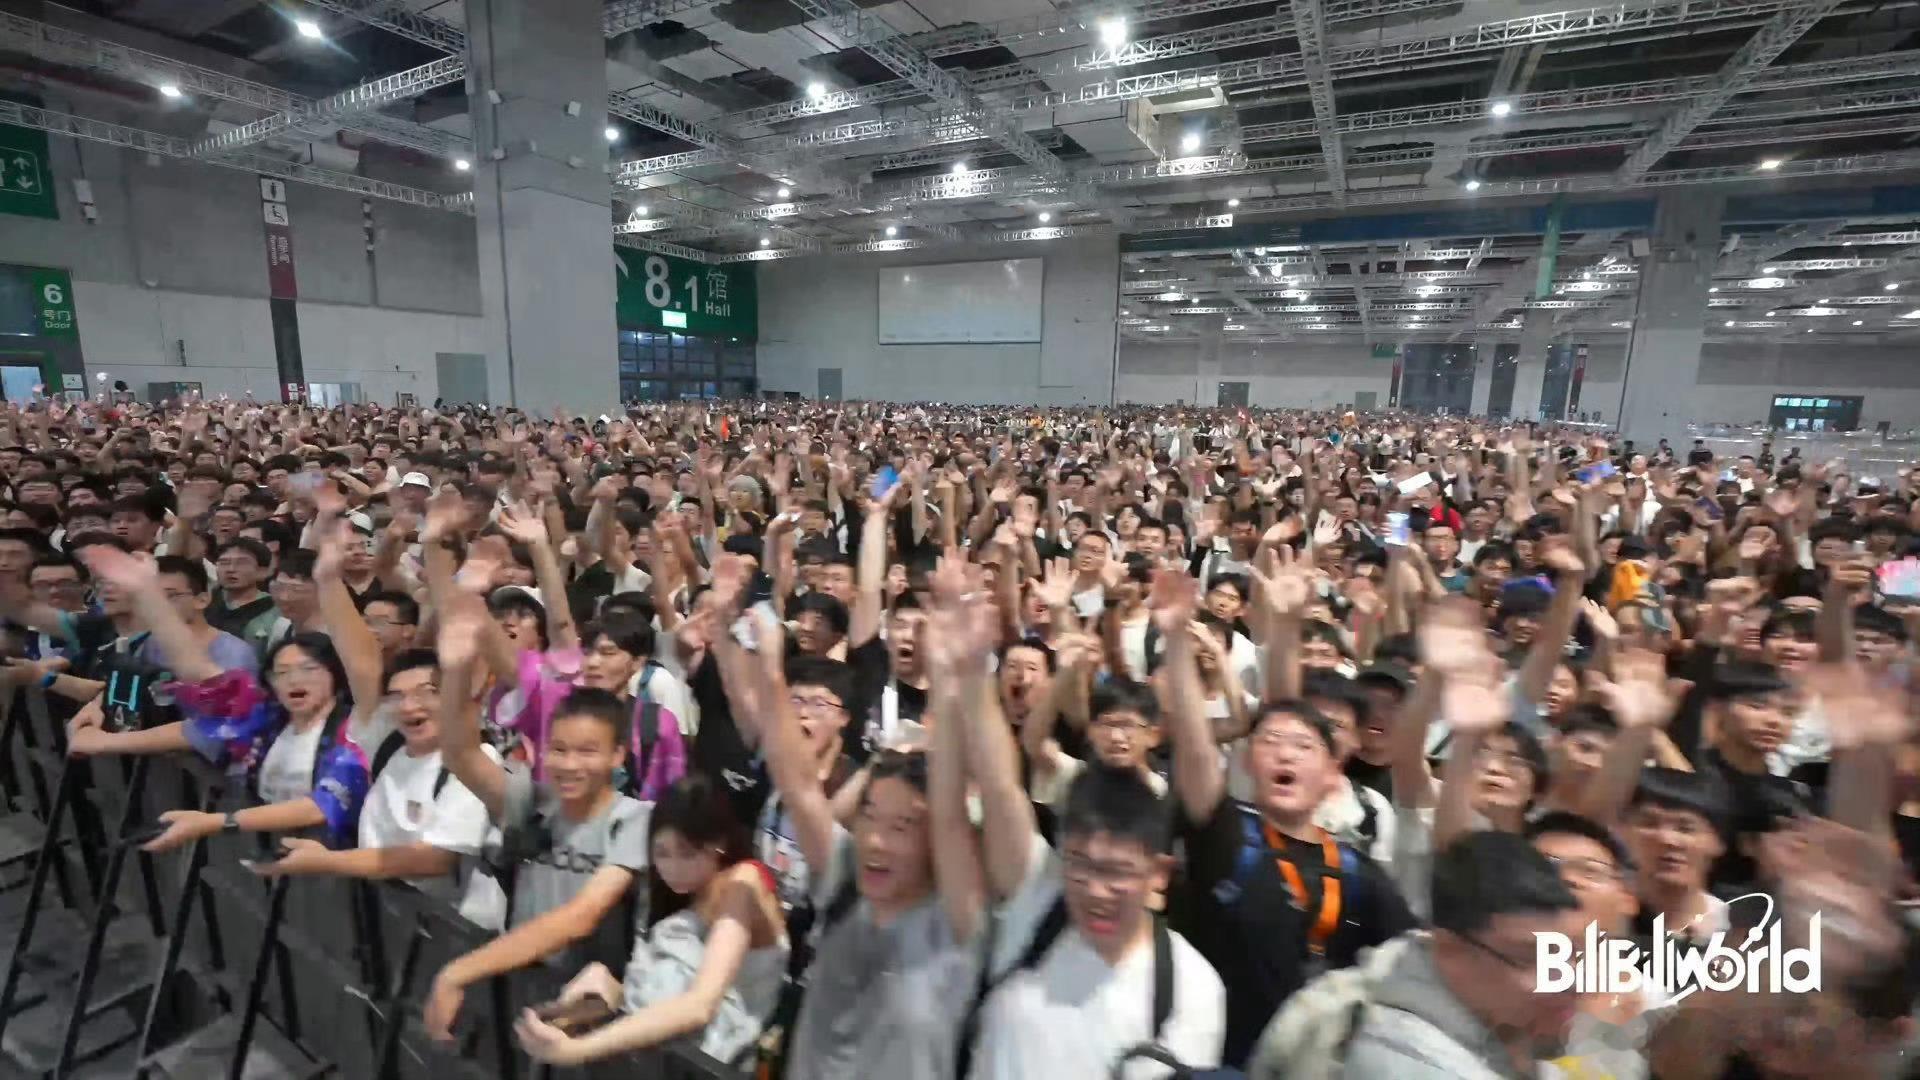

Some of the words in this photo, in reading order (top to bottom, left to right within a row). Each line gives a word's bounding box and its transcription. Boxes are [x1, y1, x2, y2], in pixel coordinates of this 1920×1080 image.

[43, 283, 63, 304] 6
[644, 255, 698, 312] 8.1
[706, 268, 728, 301] 馆
[705, 301, 731, 317] Hall
[45, 320, 71, 329] Door
